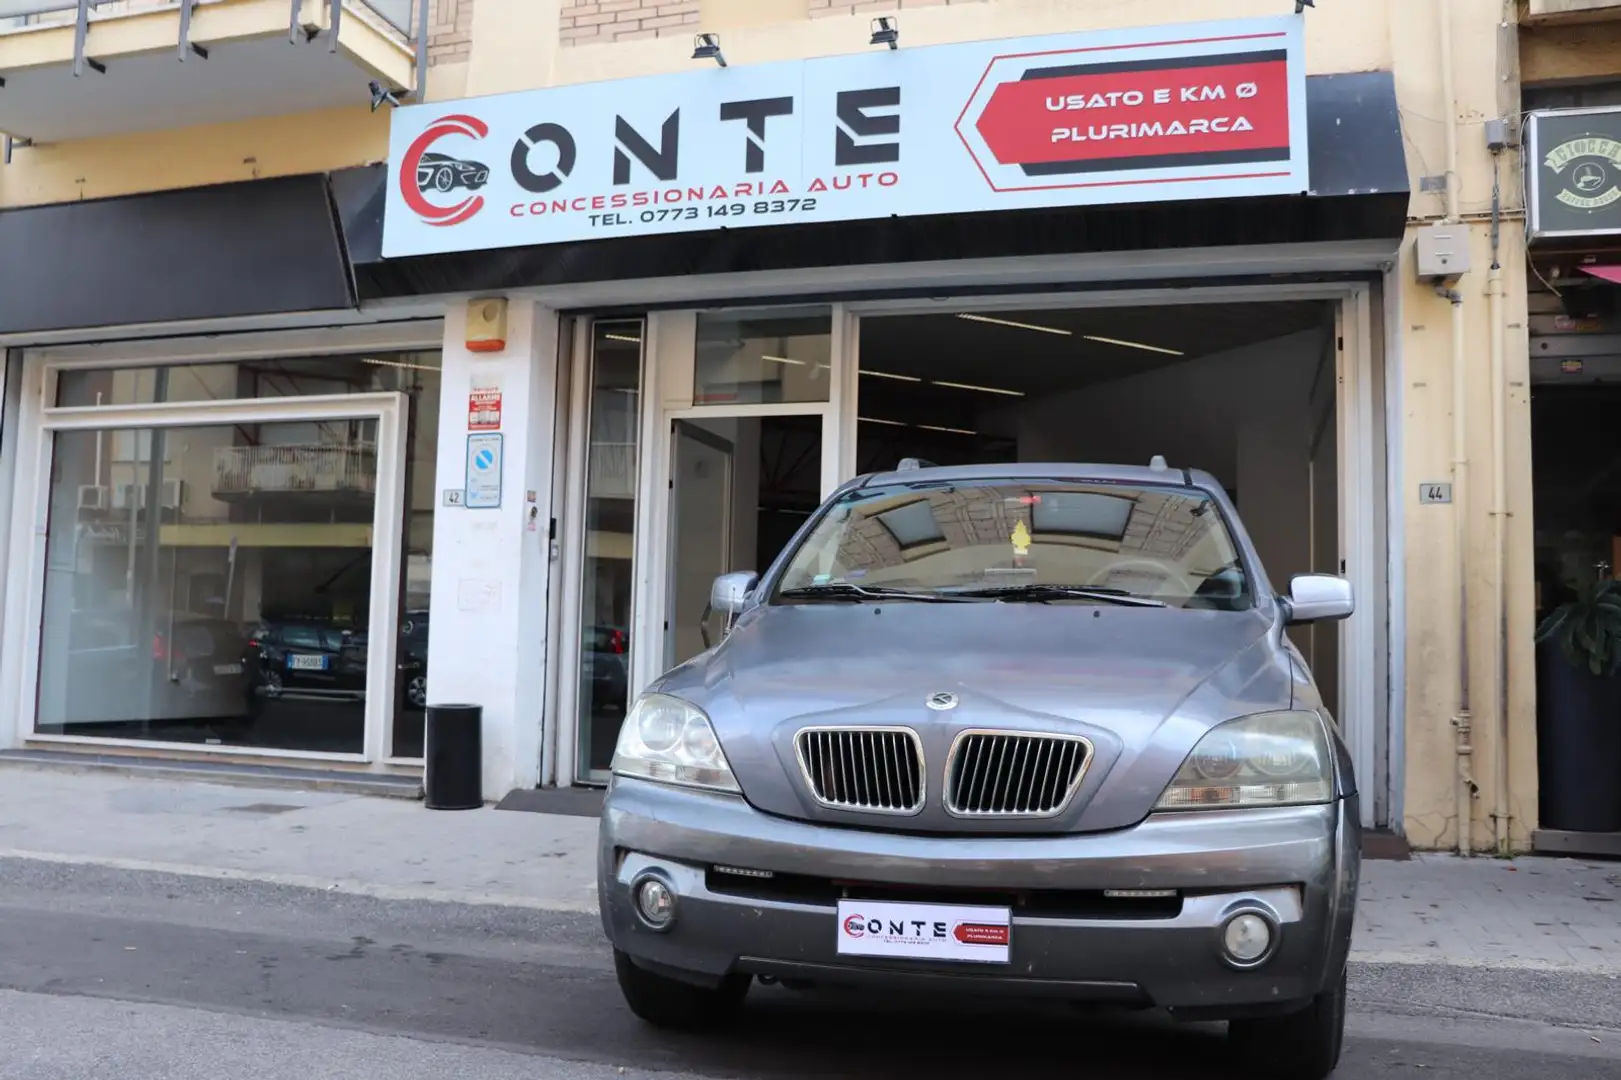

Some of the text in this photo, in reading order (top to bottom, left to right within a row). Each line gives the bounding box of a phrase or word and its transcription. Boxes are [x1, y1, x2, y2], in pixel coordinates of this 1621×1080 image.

[1045, 91, 1144, 111] USATO
[1153, 88, 1171, 104] E
[1181, 84, 1226, 102] KM
[1051, 116, 1254, 143] PLURIMARCA
[400, 86, 901, 226] CONTE
[510, 171, 899, 218] CONCESSIONARIA AUTO
[589, 198, 818, 227] TEL. 0773 149 8372
[448, 491, 460, 504] 42
[1428, 486, 1443, 500] 44
[843, 913, 947, 939] CONTE
